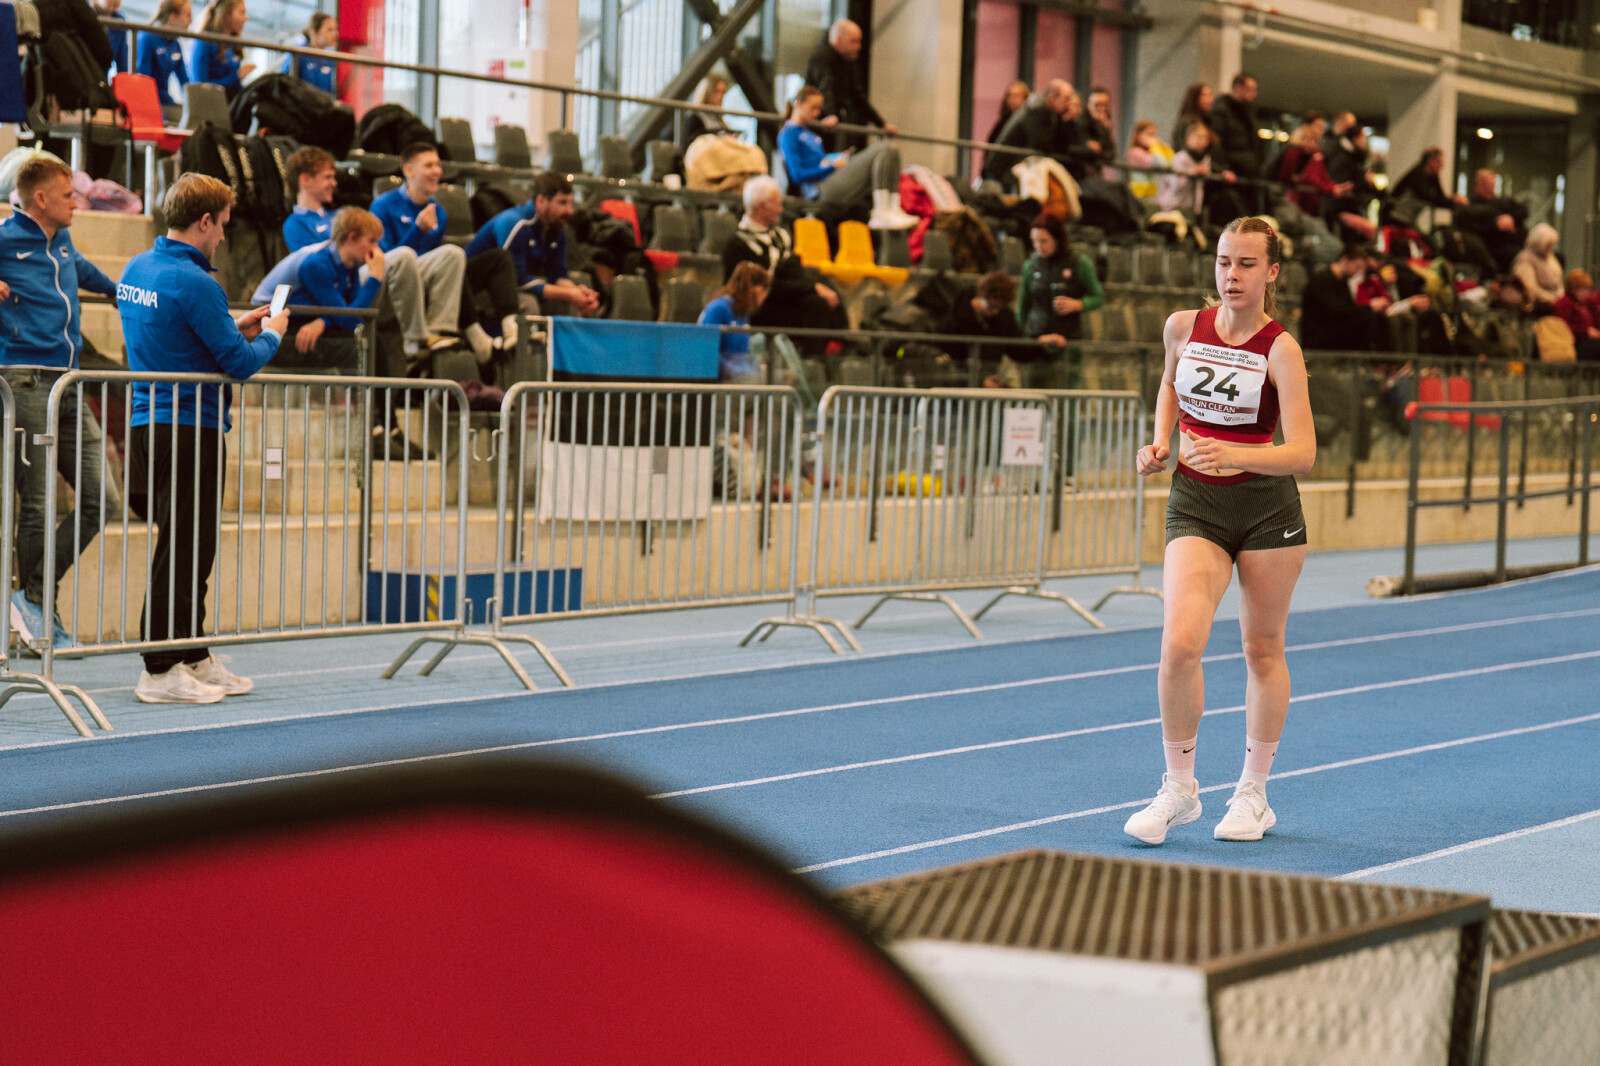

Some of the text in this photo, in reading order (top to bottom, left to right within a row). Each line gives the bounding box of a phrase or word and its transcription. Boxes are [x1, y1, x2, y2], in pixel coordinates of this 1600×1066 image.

[117, 283, 158, 309] ESTONIA
[1205, 352, 1245, 363] CHAMPIONSIPS
[1190, 366, 1240, 401] 24
[1191, 398, 1207, 408] RUN
